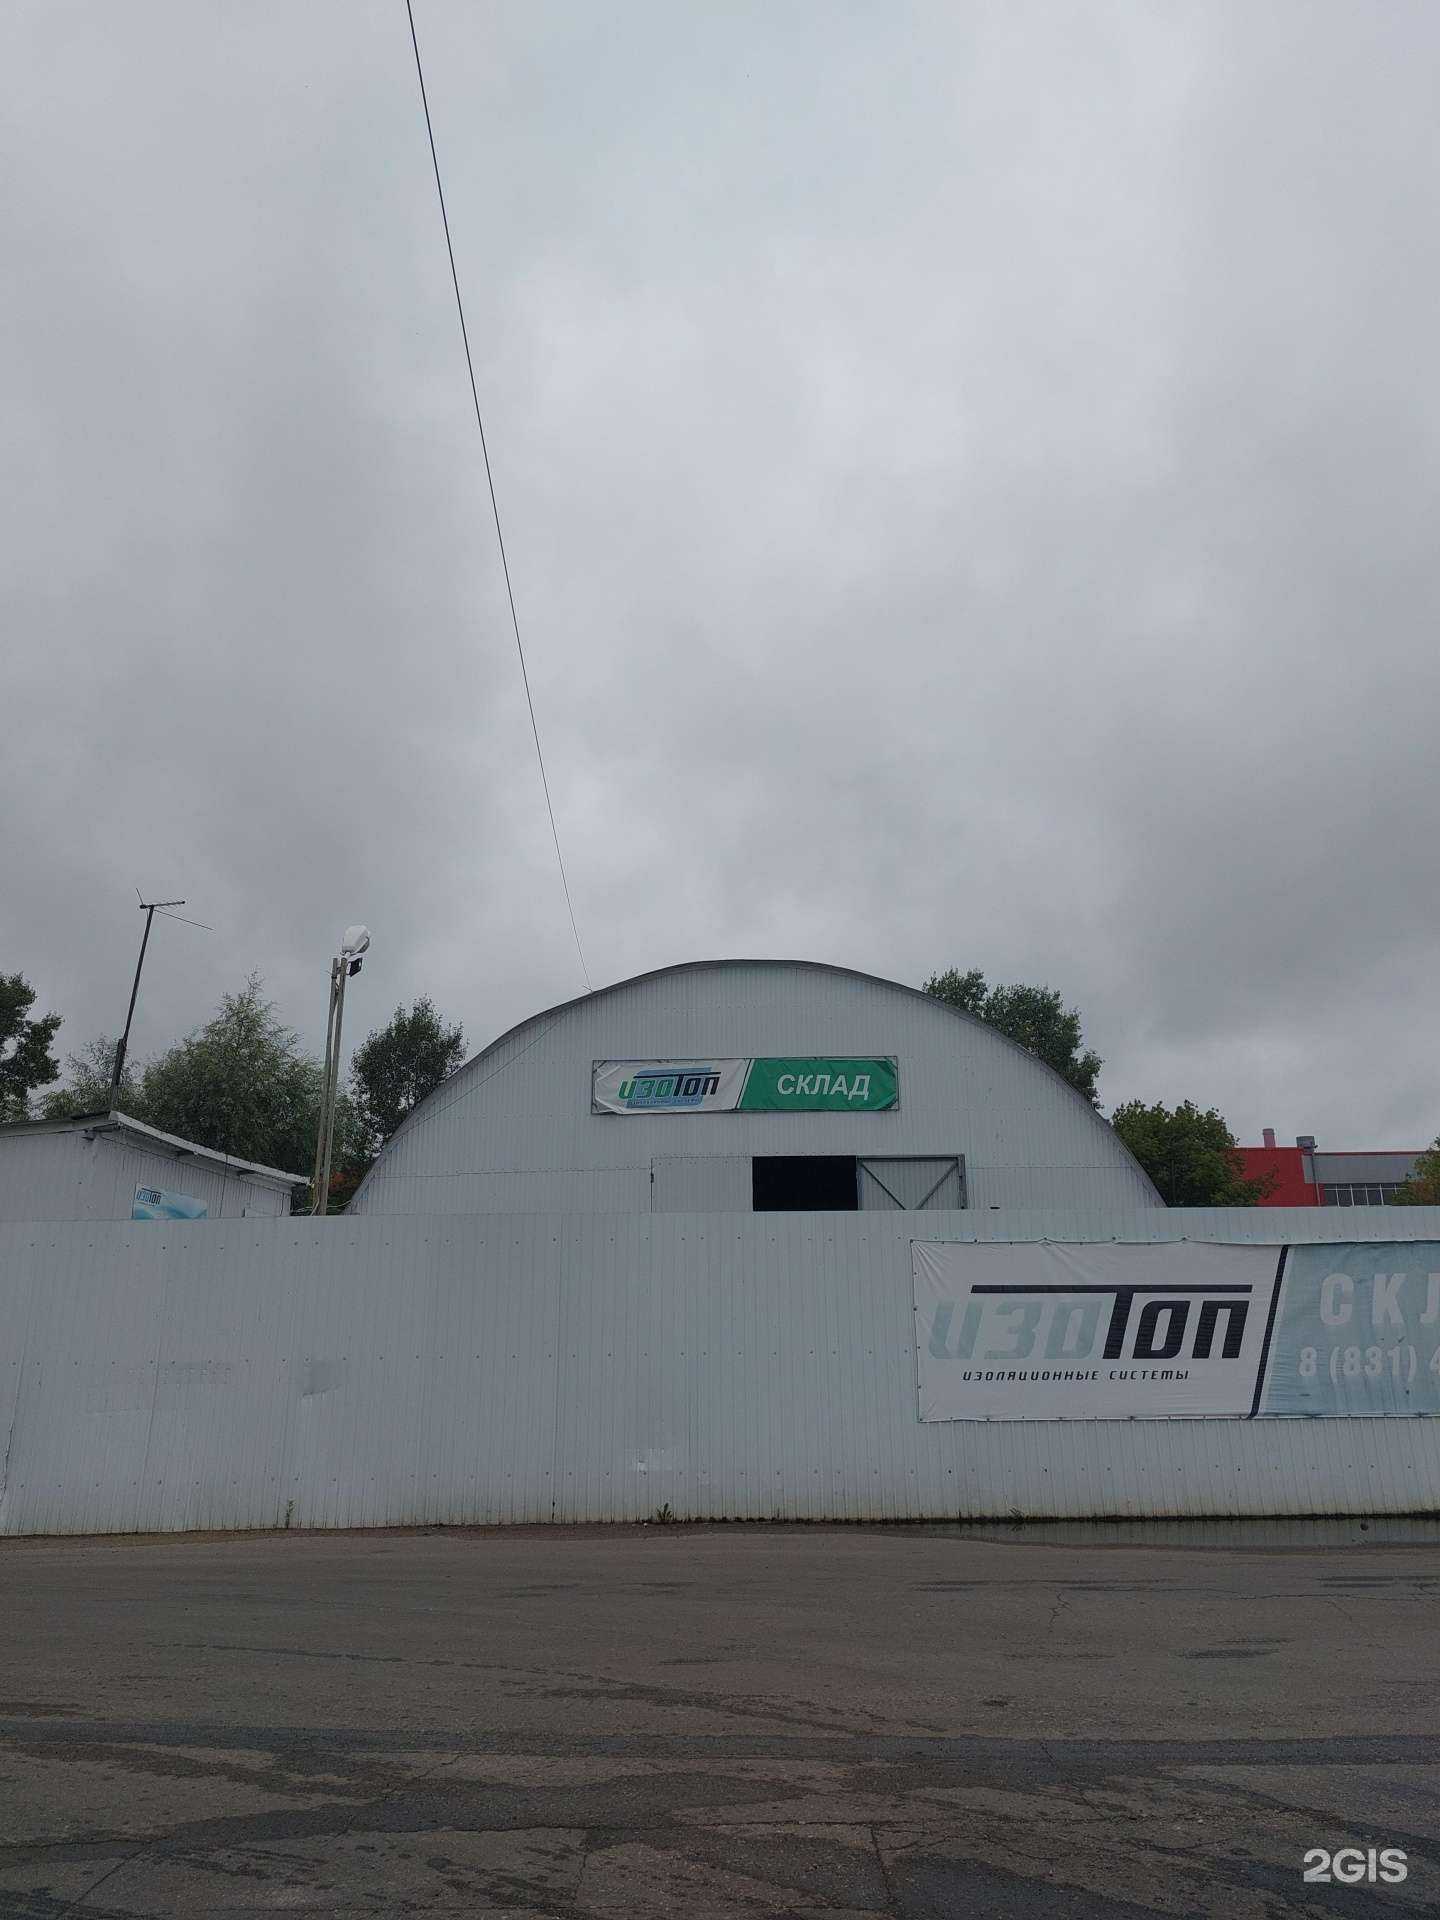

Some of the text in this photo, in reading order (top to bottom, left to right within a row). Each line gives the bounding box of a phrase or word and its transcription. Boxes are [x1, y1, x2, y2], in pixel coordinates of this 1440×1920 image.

[777, 1074, 871, 1100] СКЛАД
[1299, 1346, 1317, 1377] 8
[1329, 1344, 1417, 1384] (831)
